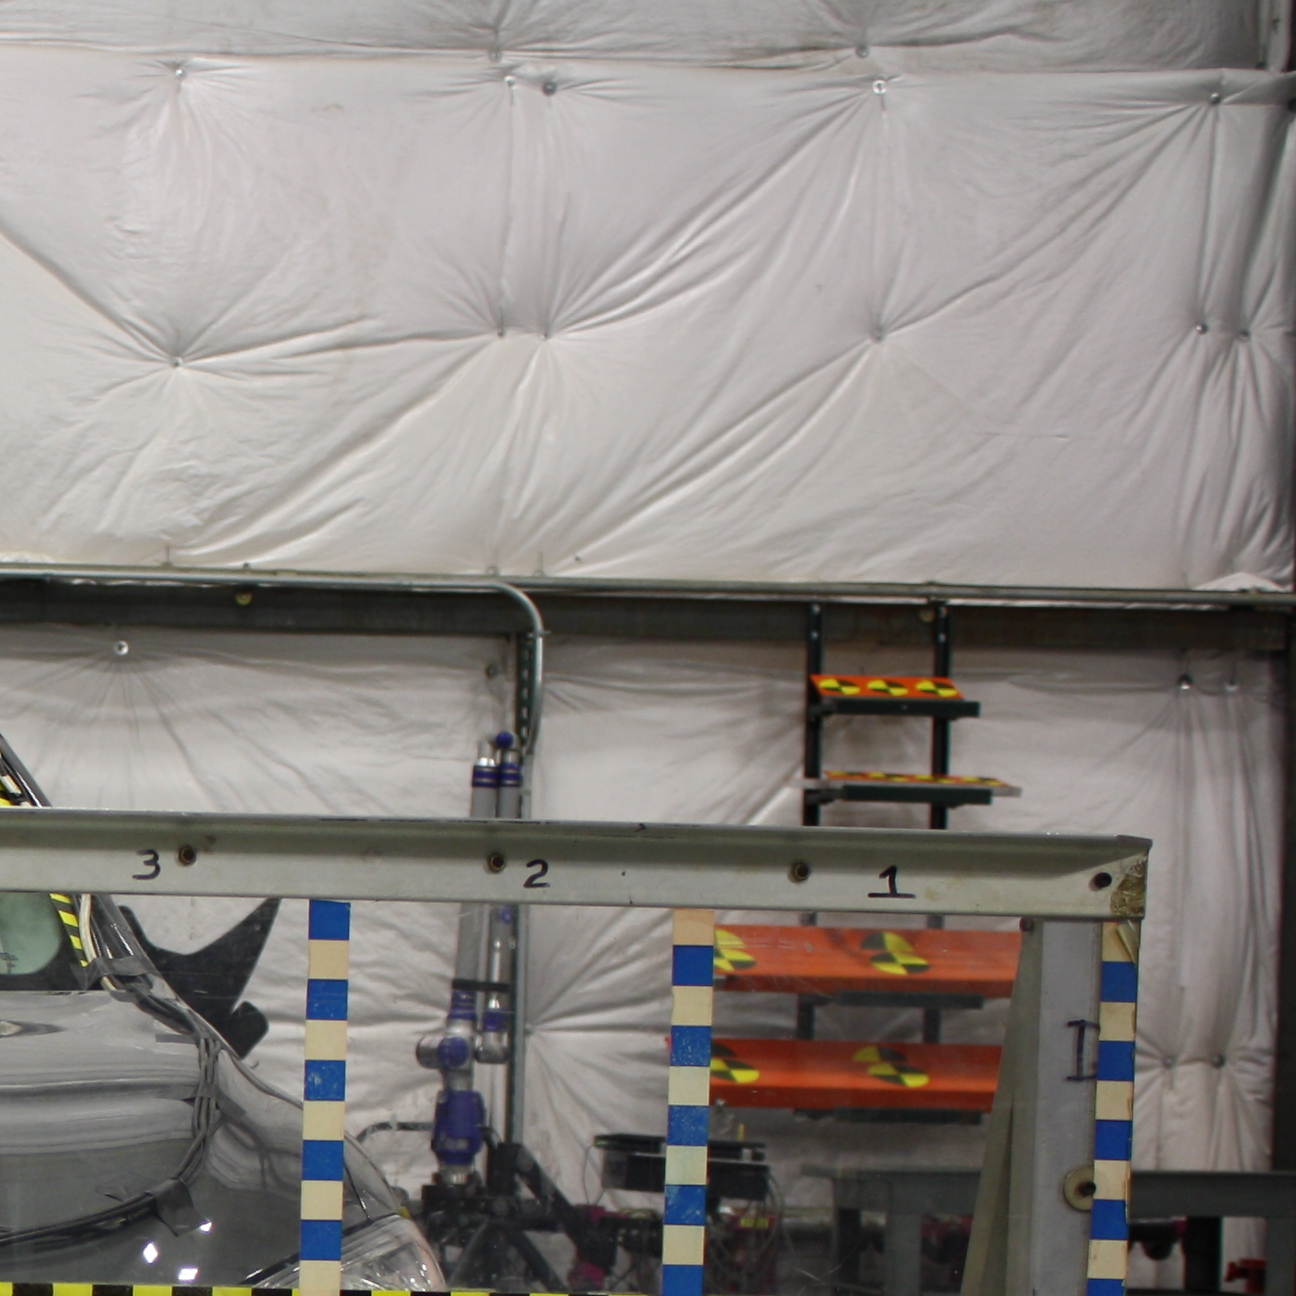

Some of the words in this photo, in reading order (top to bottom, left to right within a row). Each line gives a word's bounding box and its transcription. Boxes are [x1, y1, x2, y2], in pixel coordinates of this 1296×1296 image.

[132, 849, 161, 880] 3
[523, 859, 550, 888] 2
[868, 865, 916, 898] 1
